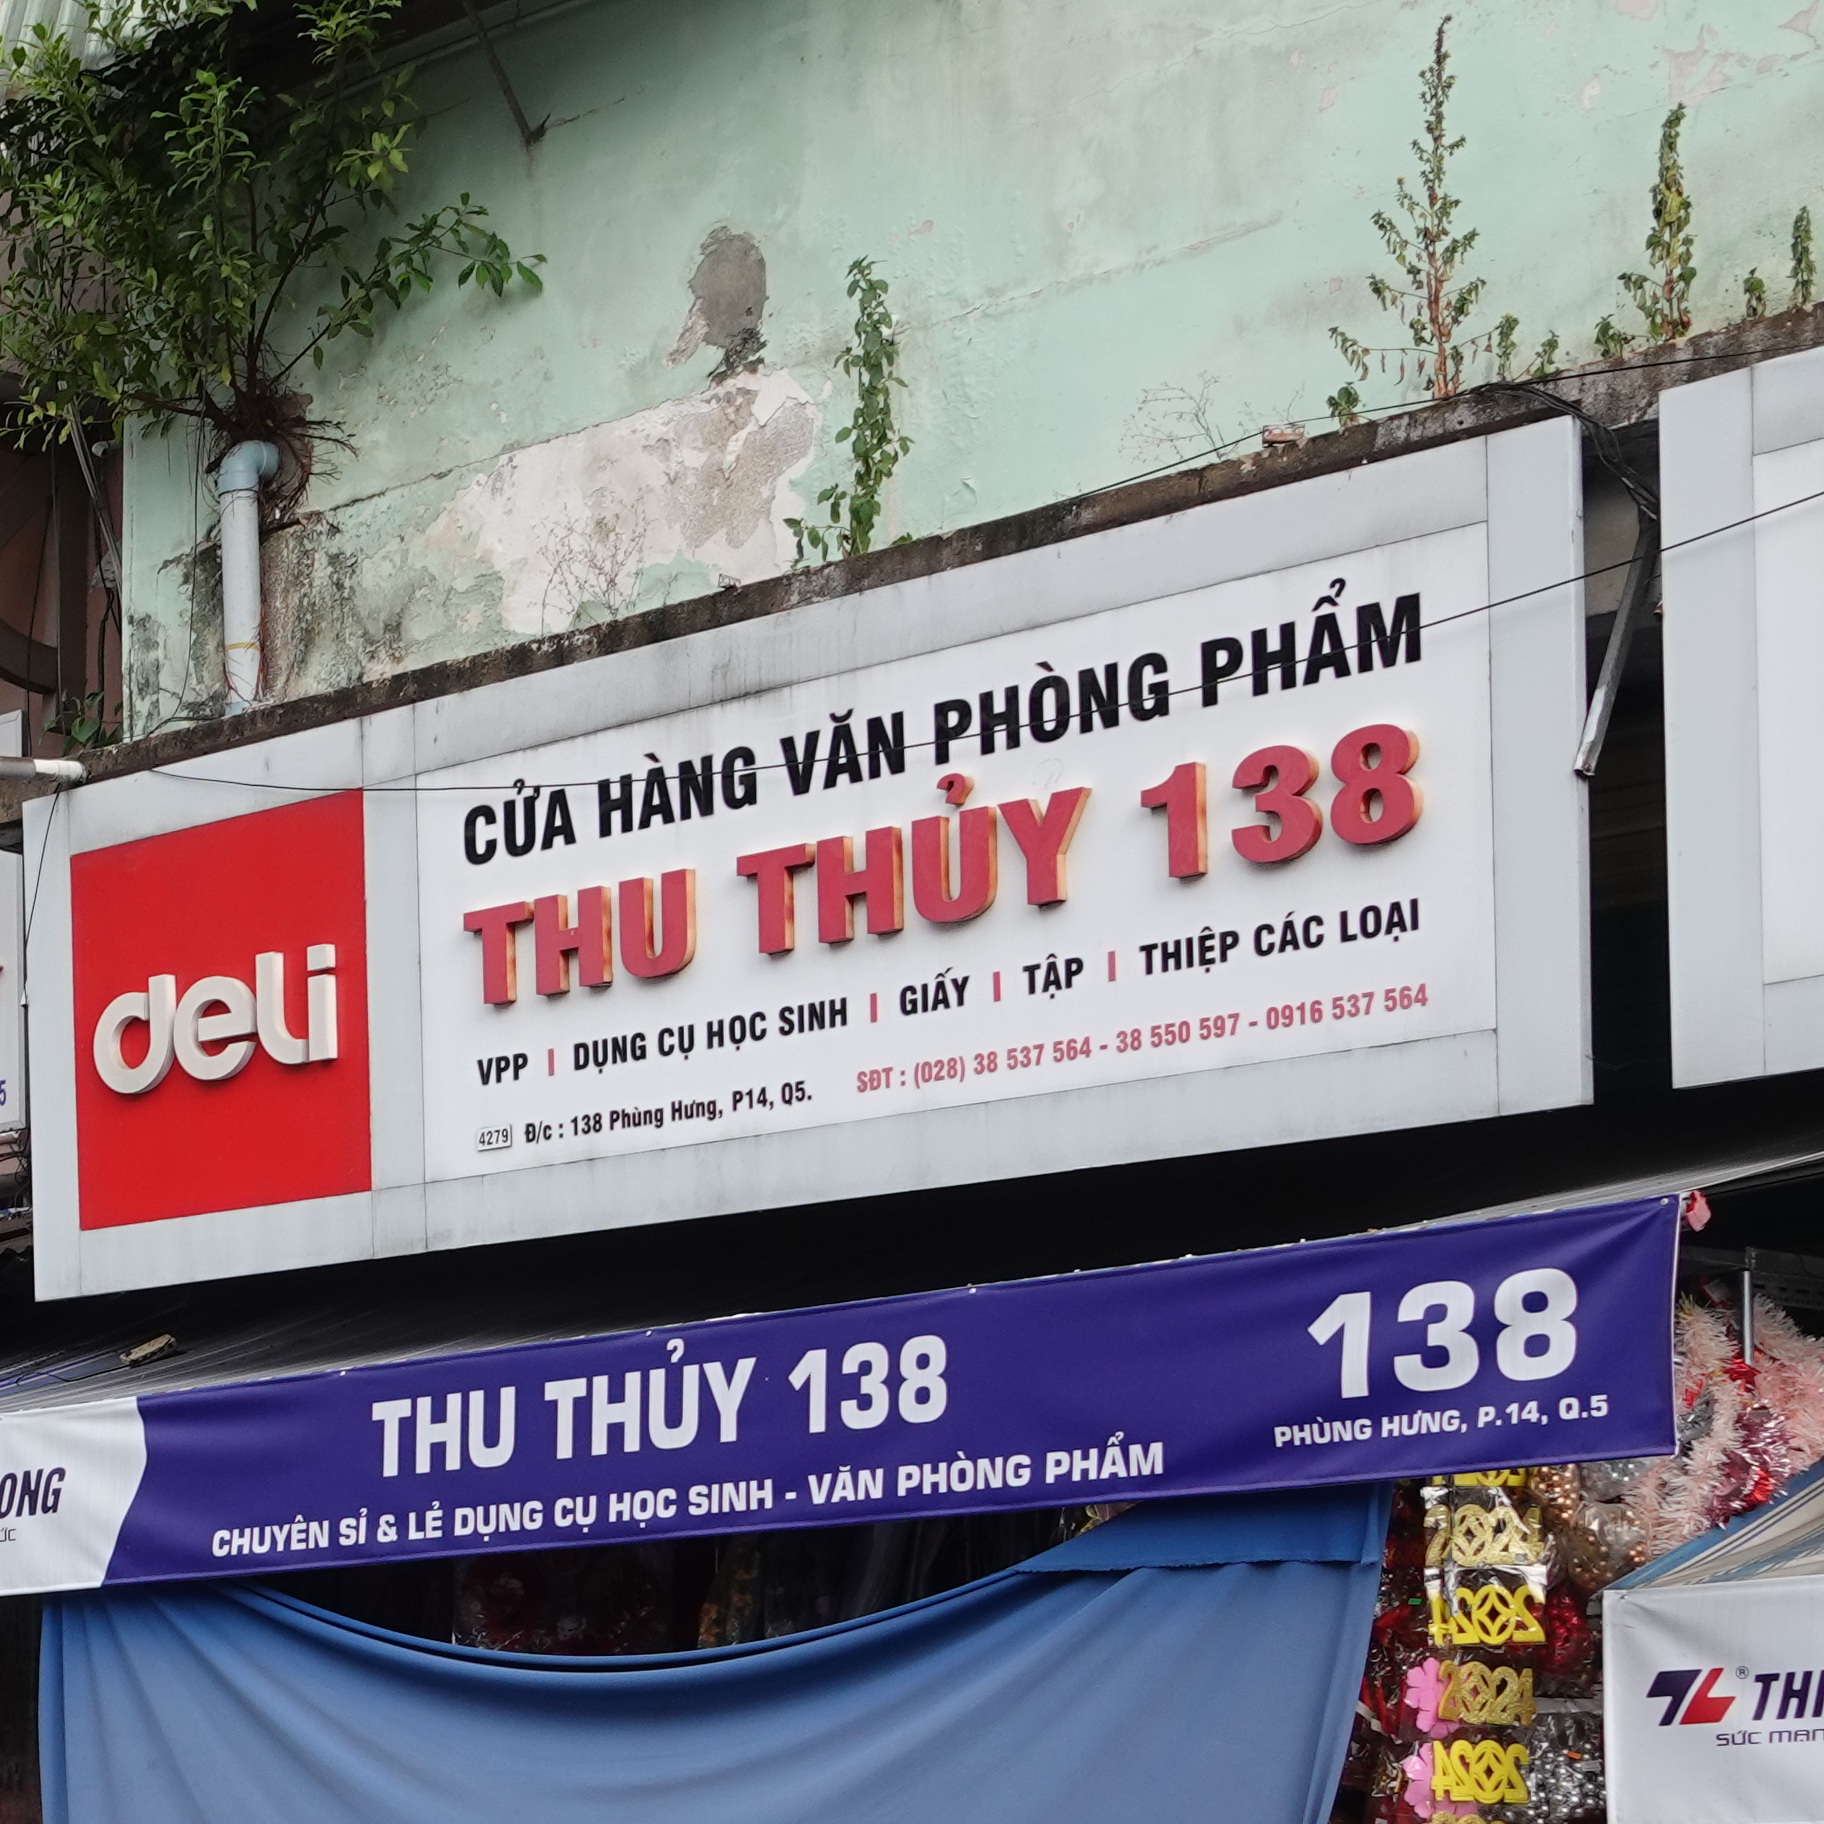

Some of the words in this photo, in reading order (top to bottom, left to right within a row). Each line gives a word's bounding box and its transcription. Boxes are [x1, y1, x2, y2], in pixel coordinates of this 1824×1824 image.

[463, 779, 576, 865] CỬA
[598, 746, 758, 838] HÀNG
[780, 708, 905, 796] VĂN
[934, 653, 1171, 766] PHÒNG
[1201, 578, 1423, 708] PHẨM
[463, 868, 696, 1006] THU
[737, 772, 1092, 956] THỦY
[1140, 723, 1423, 879] 138
[92, 942, 338, 1100] deli
[477, 1052, 529, 1086] VPP
[573, 1033, 648, 1074] DỤNG
[657, 1024, 695, 1060] CỤ
[706, 1010, 768, 1052] HỌC
[778, 997, 849, 1035] SINH
[899, 967, 970, 1016] GIẤY
[1023, 953, 1084, 999] TẬP
[1139, 926, 1240, 976] THIỆP
[1253, 907, 1325, 957] CÁC
[1338, 898, 1420, 943] LOẠI
[478, 1127, 510, 1147] 4279
[570, 1112, 603, 1137] 138
[609, 1105, 664, 1132] Phùng
[671, 1095, 724, 1126] Hưng,
[732, 1088, 774, 1115] P14,
[371, 1385, 518, 1478] THU
[544, 1338, 757, 1461] THỦY
[789, 1334, 949, 1435] 138
[1307, 1267, 1581, 1401] 138
[1274, 1410, 1370, 1448] PHÙNG
[1381, 1402, 1469, 1442] HƯNG,
[1477, 1401, 1549, 1433] P.14,
[1558, 1393, 1610, 1421] Q.5
[211, 1512, 330, 1559] CHUYÊN
[339, 1504, 369, 1547] SỈ
[377, 1512, 398, 1543] &
[407, 1498, 445, 1541] LẺ
[453, 1499, 541, 1548] DỤNG
[553, 1494, 598, 1536] CỤ
[608, 1489, 677, 1531] HỌC
[688, 1475, 774, 1517] SINH
[807, 1456, 885, 1508] VĂN
[896, 1447, 1031, 1499] PHÒNG
[1045, 1431, 1164, 1486] PHẨM
